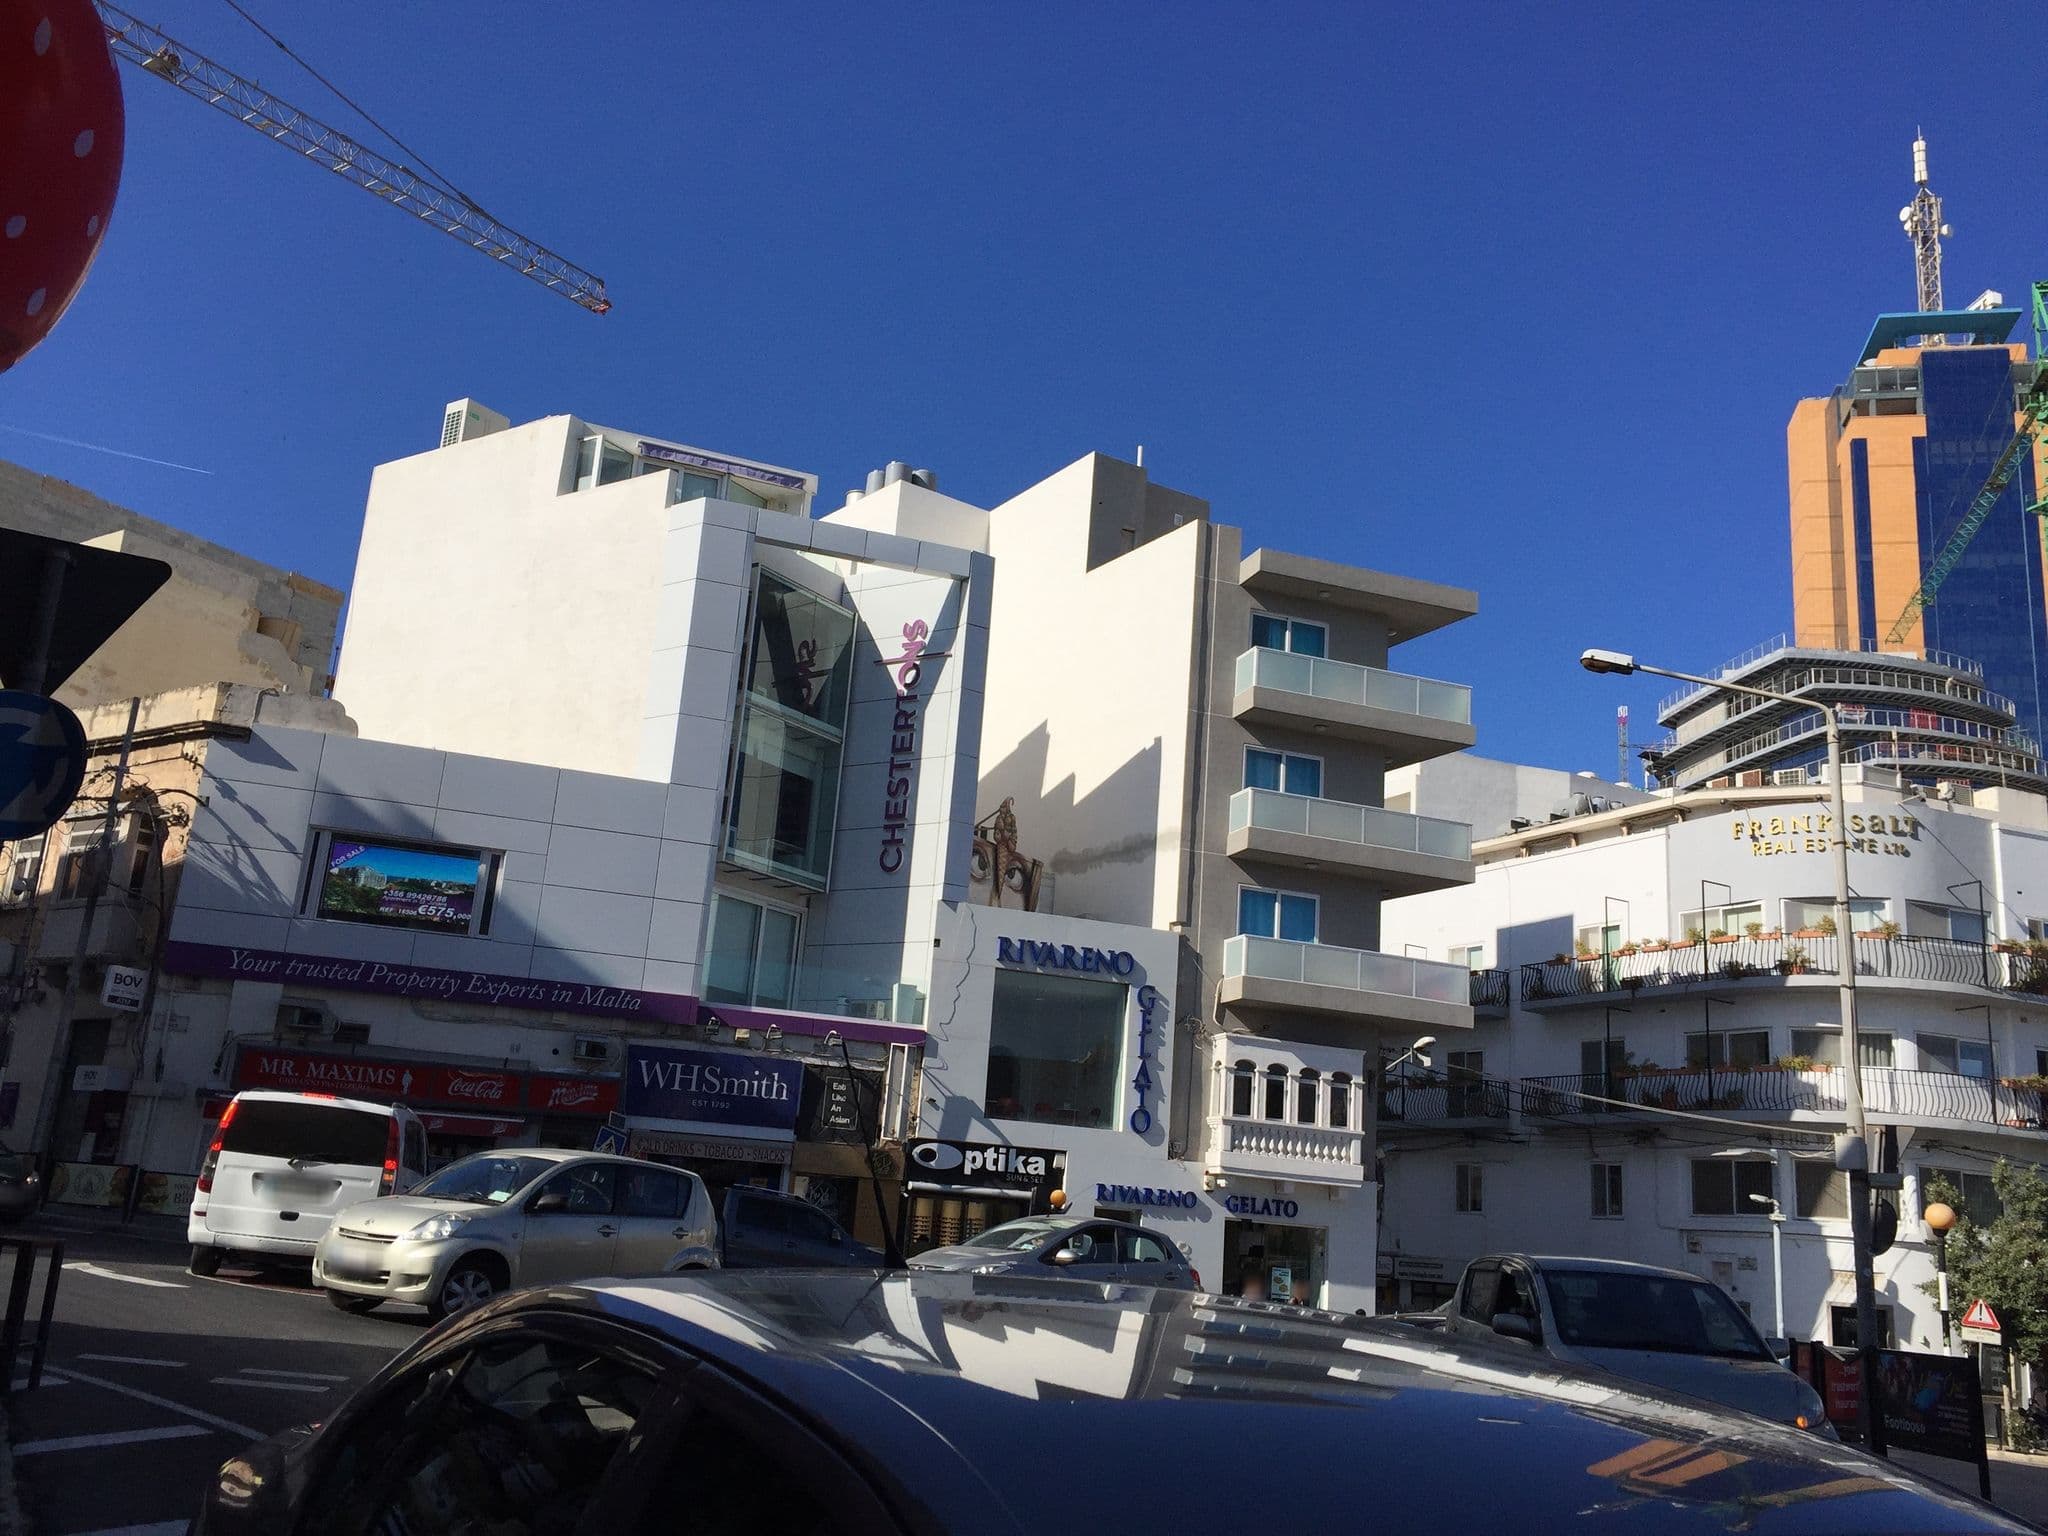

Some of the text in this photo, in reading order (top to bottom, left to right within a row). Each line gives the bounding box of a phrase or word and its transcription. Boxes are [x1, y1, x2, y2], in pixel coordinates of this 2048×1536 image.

[879, 618, 930, 874] CHESTERTONS
[346, 845, 365, 859] SALE
[1752, 839, 1797, 856] REAL
[997, 936, 1135, 976] RIVARENO
[114, 972, 143, 988] BOV
[229, 949, 641, 1010] Your trusted Property Experts in Malta
[259, 1056, 396, 1085] MR. MAXIMS
[1130, 985, 1156, 1134] GELATO
[638, 1058, 789, 1101] WHSmith
[692, 1098, 730, 1110] EST 1792
[830, 1103, 842, 1112] An
[829, 1115, 850, 1124] Asian
[663, 1141, 695, 1155] DRINKS
[703, 1145, 743, 1159] TOBACCO
[752, 1148, 785, 1162] SNACKS
[1096, 1183, 1198, 1209] RIVARENO
[1225, 1195, 1299, 1219] GELATO
